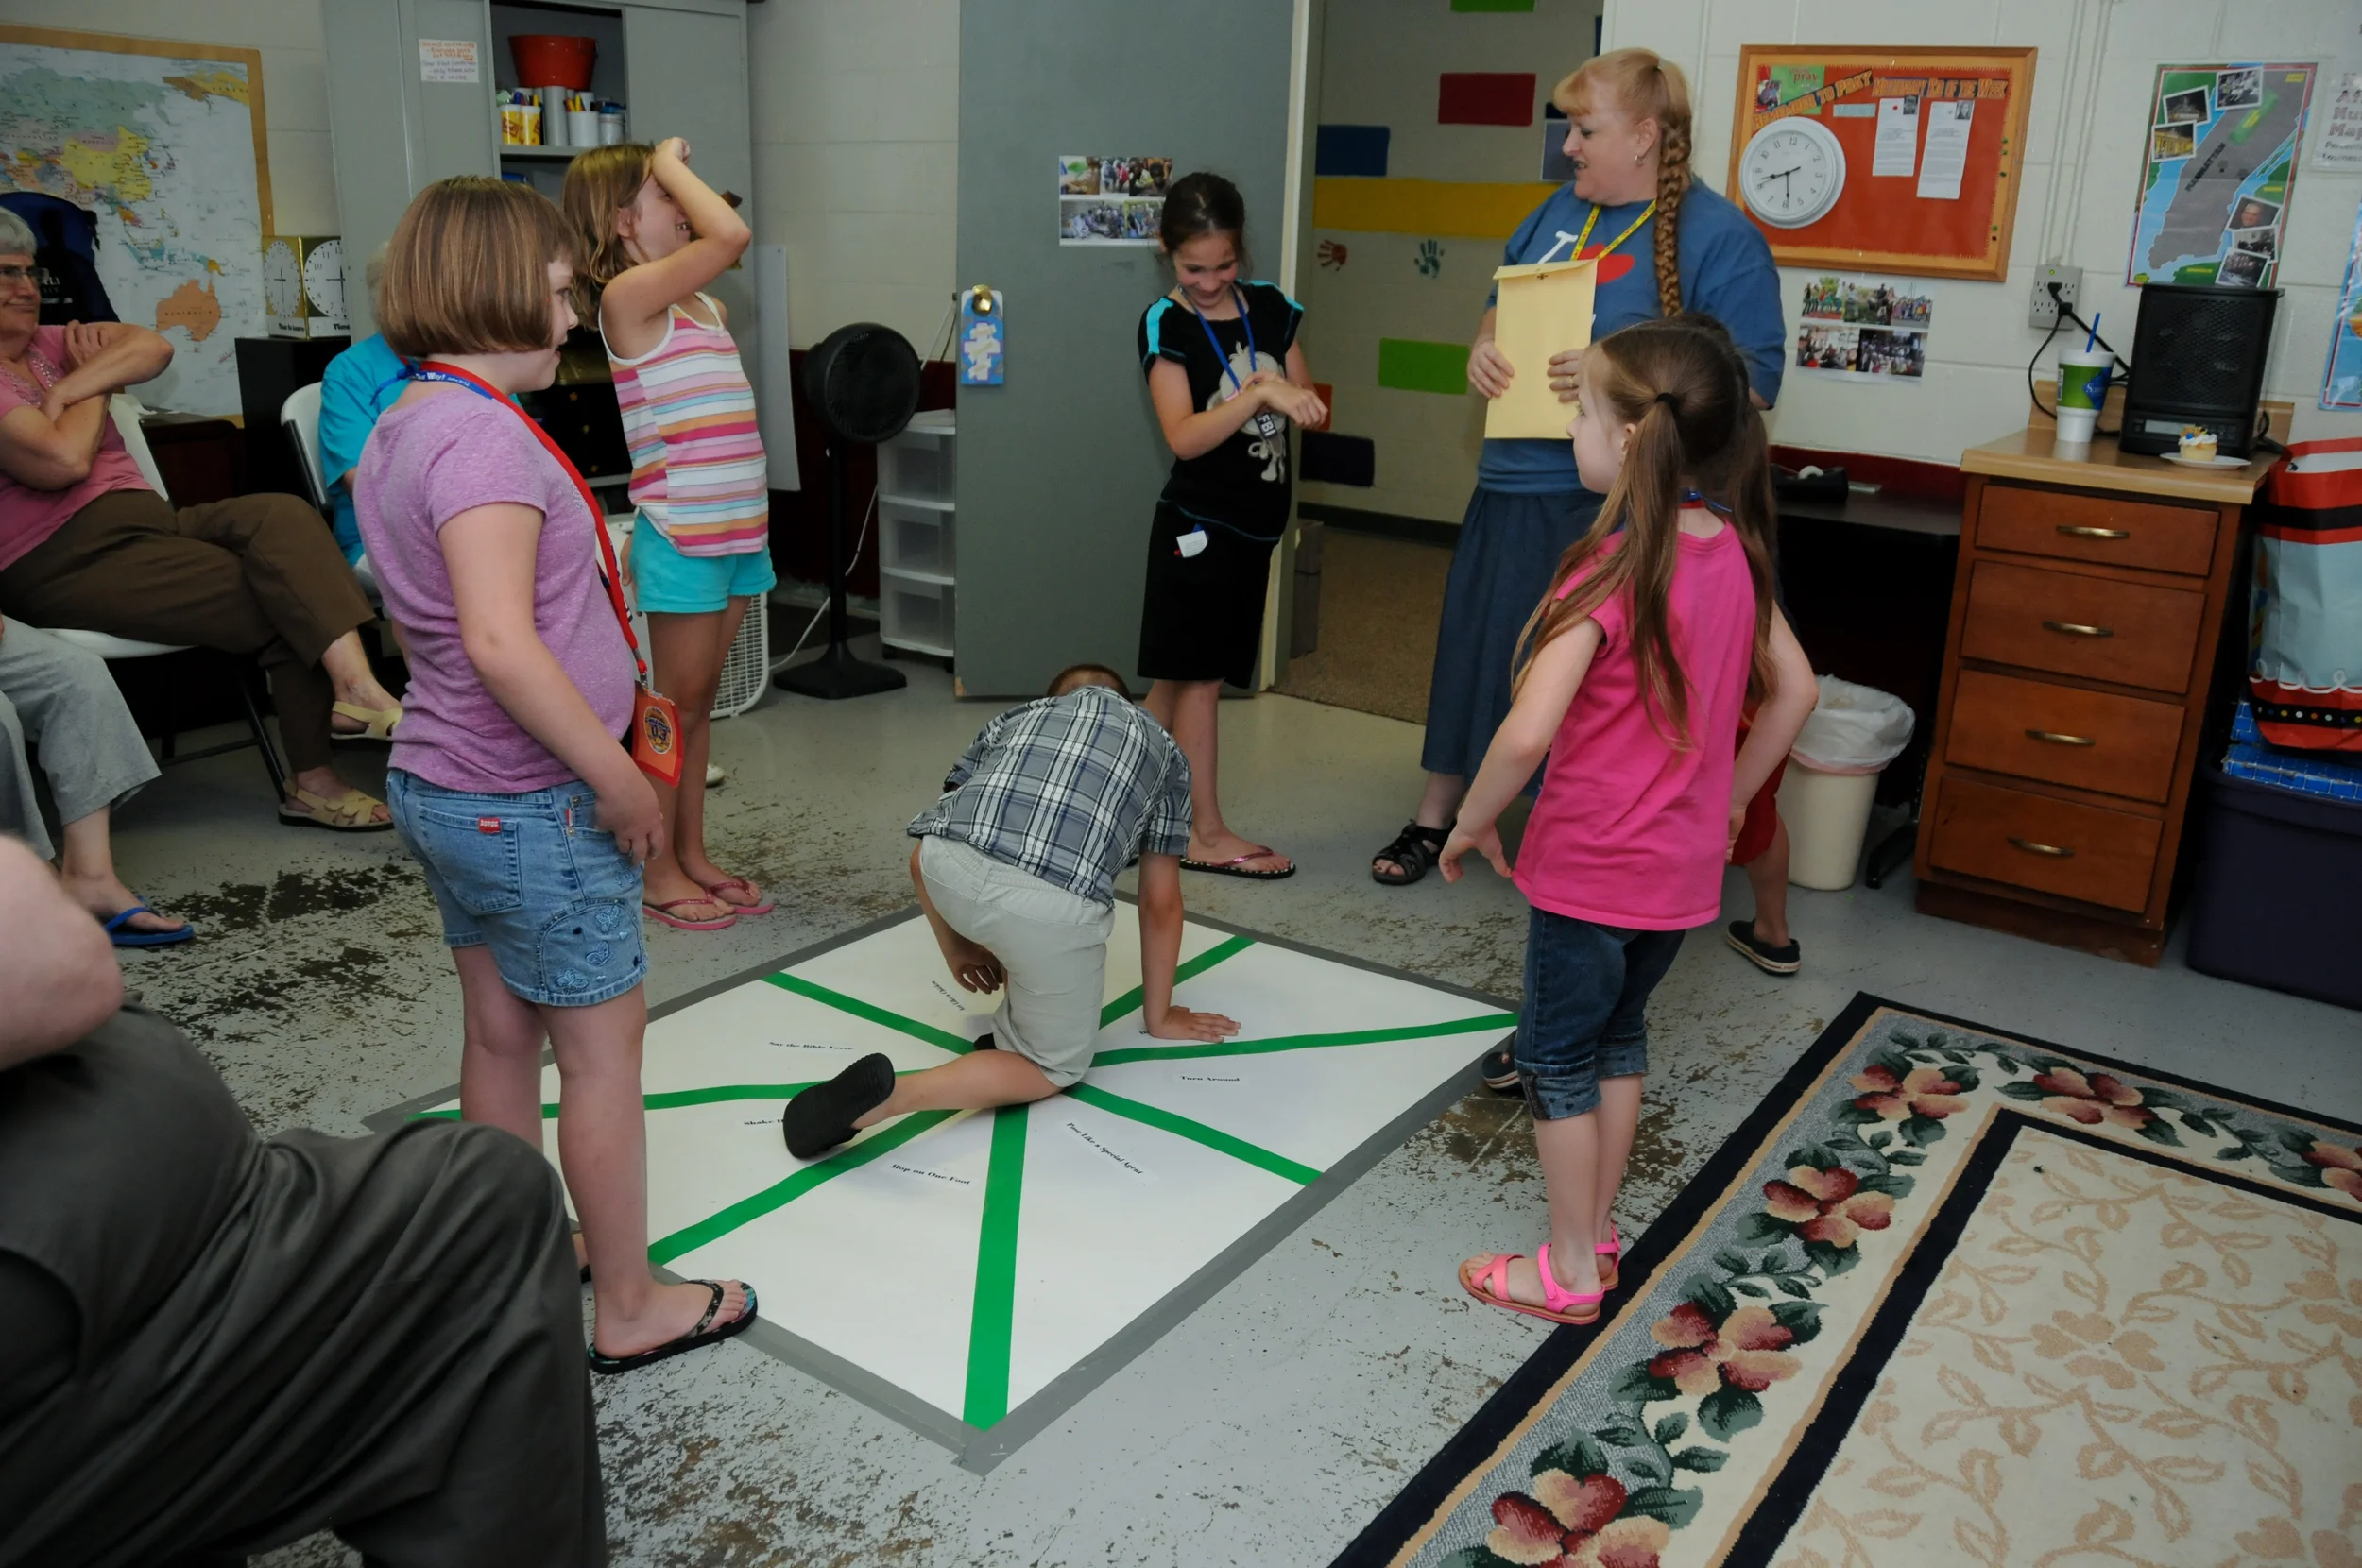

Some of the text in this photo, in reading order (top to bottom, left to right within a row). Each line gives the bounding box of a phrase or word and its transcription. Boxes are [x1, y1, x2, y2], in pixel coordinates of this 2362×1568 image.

[1792, 72, 1819, 84] pray
[1816, 84, 1836, 106] TO
[1834, 69, 1874, 99] PRAY
[1773, 140, 1781, 149] 11
[1789, 136, 1798, 145] 12
[1760, 150, 1770, 160] 10
[2185, 142, 2227, 192] MANHATTAN
[1781, 200, 1789, 209] 6
[1797, 197, 1805, 206] 5
[426, 372, 446, 381] Way!
[1258, 414, 1277, 436] FBI
[1066, 1122, 1082, 1134] Pose
[1081, 1133, 1096, 1144] Like
[1100, 1146, 1125, 1163] Special
[1123, 1161, 1143, 1175] Agent
[891, 1163, 911, 1173] Hop
[927, 1171, 947, 1180] One
[949, 1176, 971, 1185] Foot
